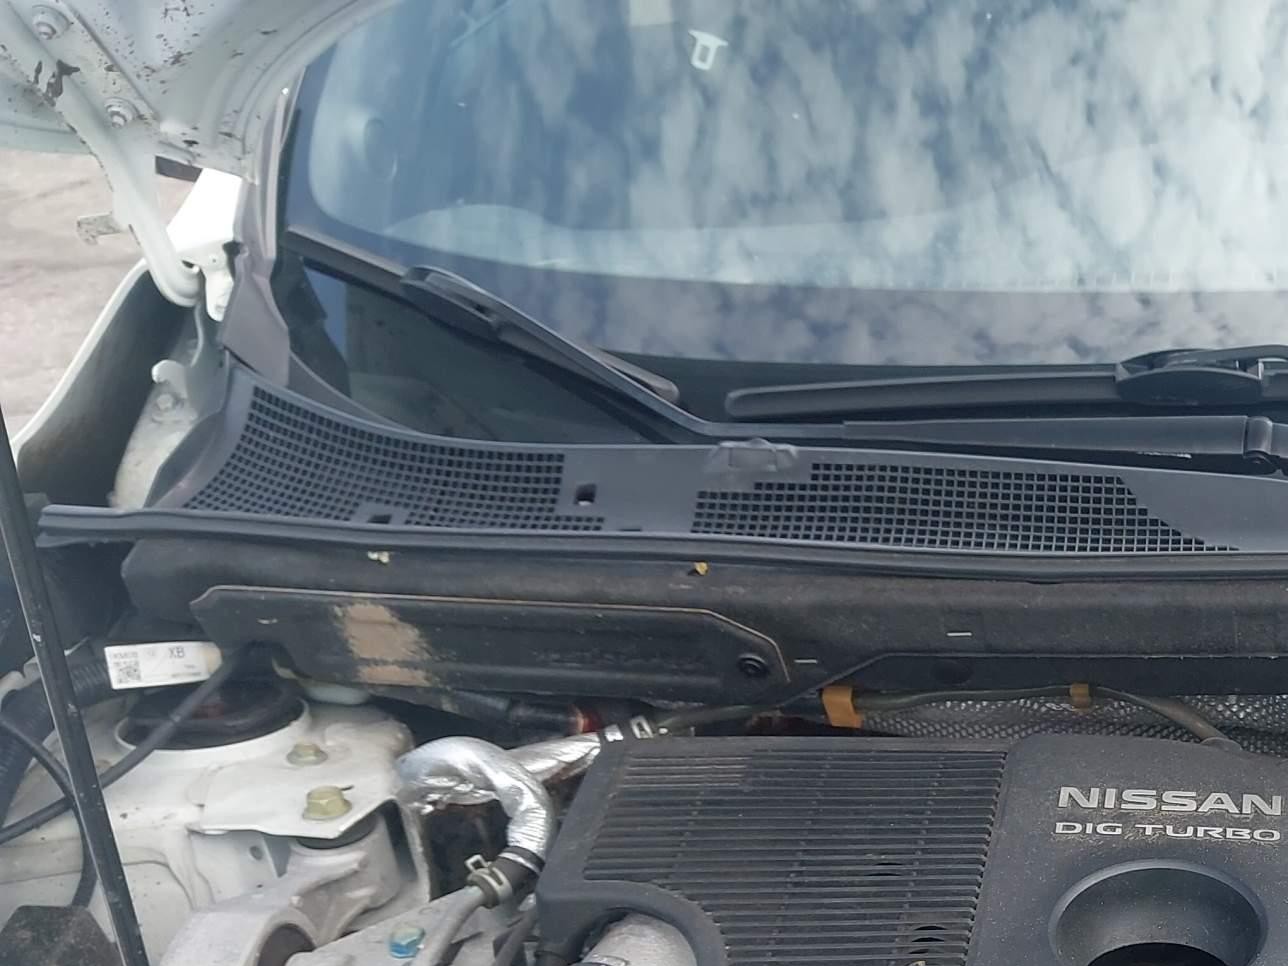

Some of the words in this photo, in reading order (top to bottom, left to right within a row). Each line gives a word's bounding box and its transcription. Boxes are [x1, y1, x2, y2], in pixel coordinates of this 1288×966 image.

[1058, 787, 1282, 816] NISSAN
[1055, 822, 1123, 835] DIG
[1135, 824, 1281, 841] TURBO
